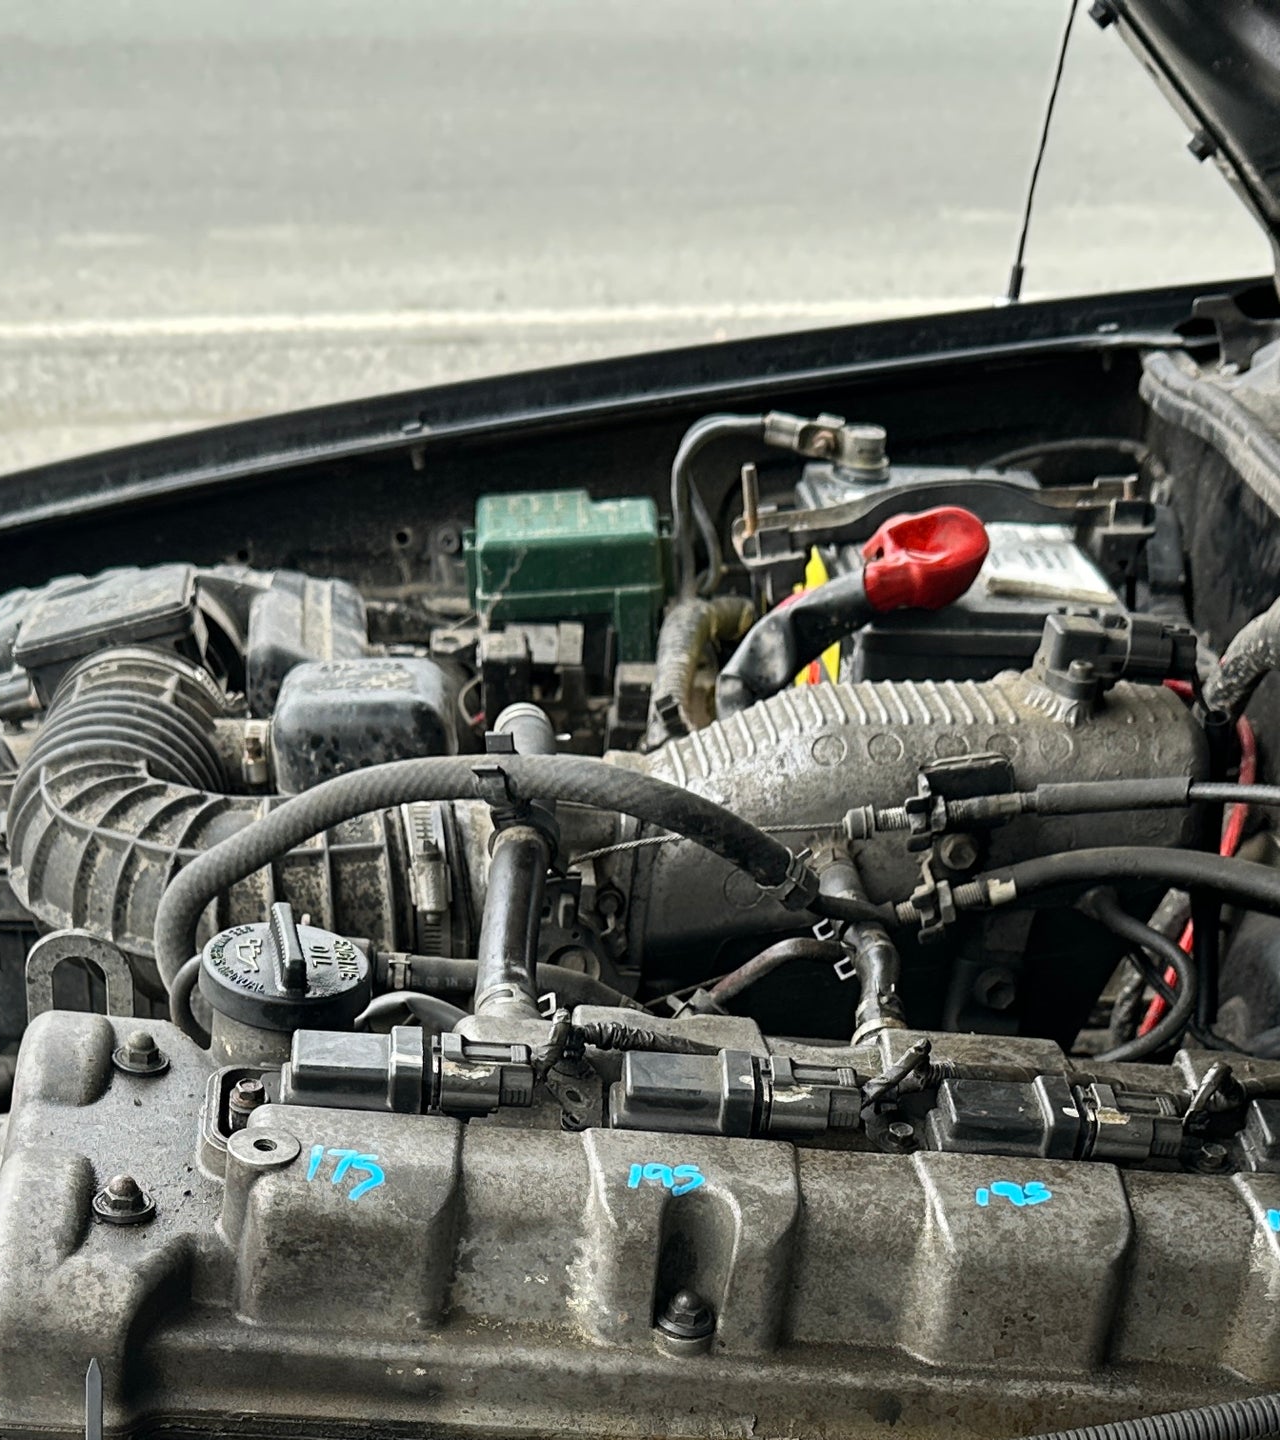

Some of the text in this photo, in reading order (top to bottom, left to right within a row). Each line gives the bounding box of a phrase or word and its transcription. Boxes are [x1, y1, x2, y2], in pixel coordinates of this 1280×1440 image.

[310, 945, 332, 968] OIL
[333, 938, 359, 981] ENGINE
[628, 1162, 706, 1196] 195
[975, 1181, 1052, 1206] 195
